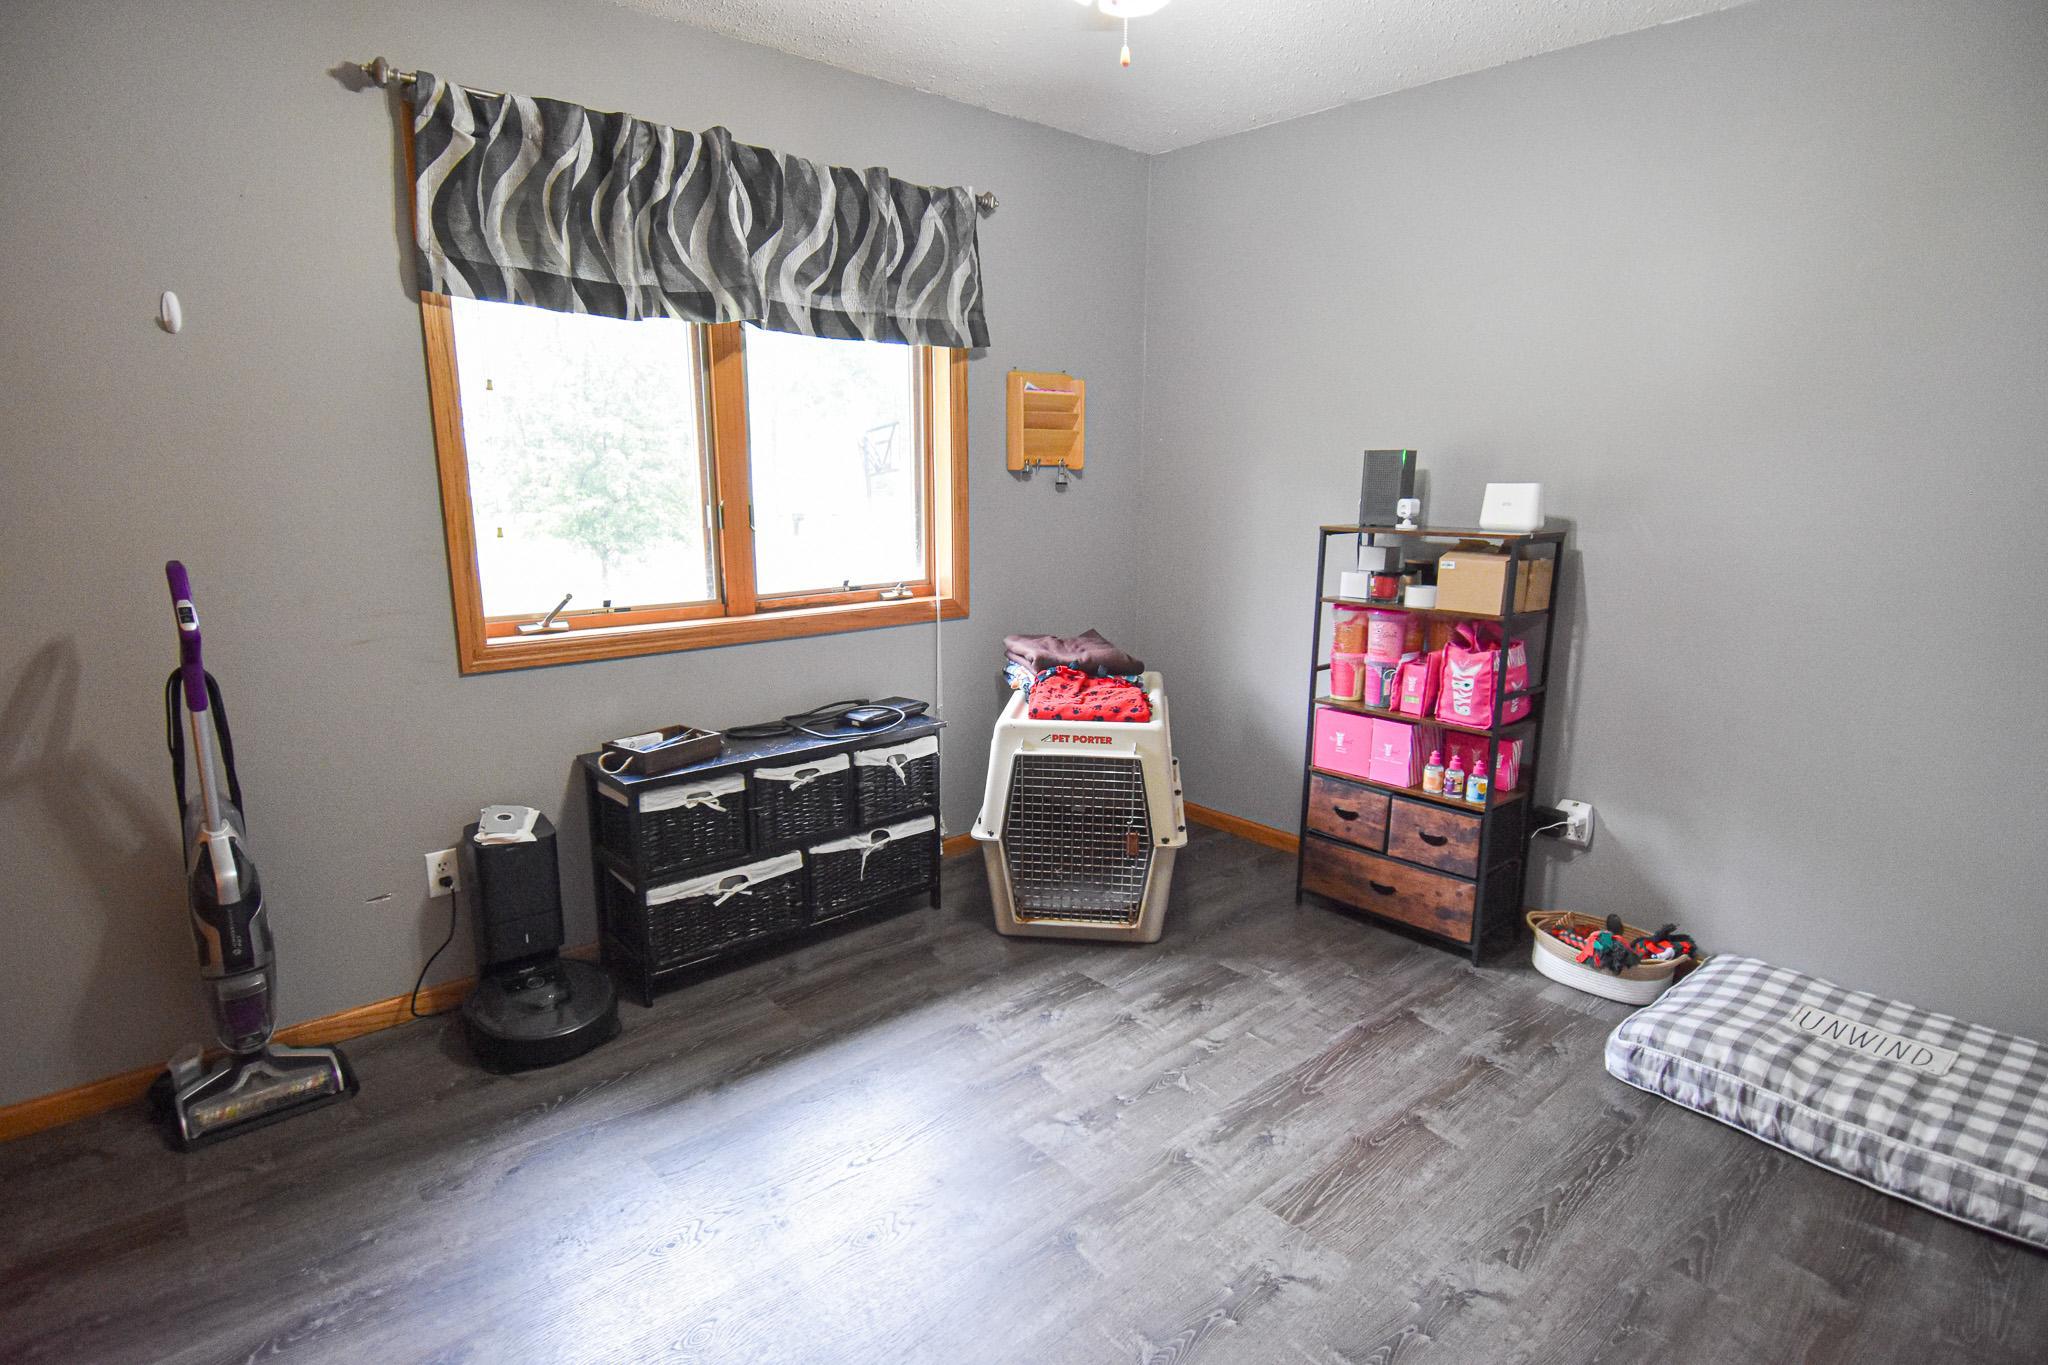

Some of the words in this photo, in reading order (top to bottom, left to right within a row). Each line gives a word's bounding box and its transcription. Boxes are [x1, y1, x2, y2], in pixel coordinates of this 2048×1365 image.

[1052, 734, 1071, 743] PET
[1073, 735, 1113, 745] PORTER
[1798, 1010, 1934, 1067] UNWIND
